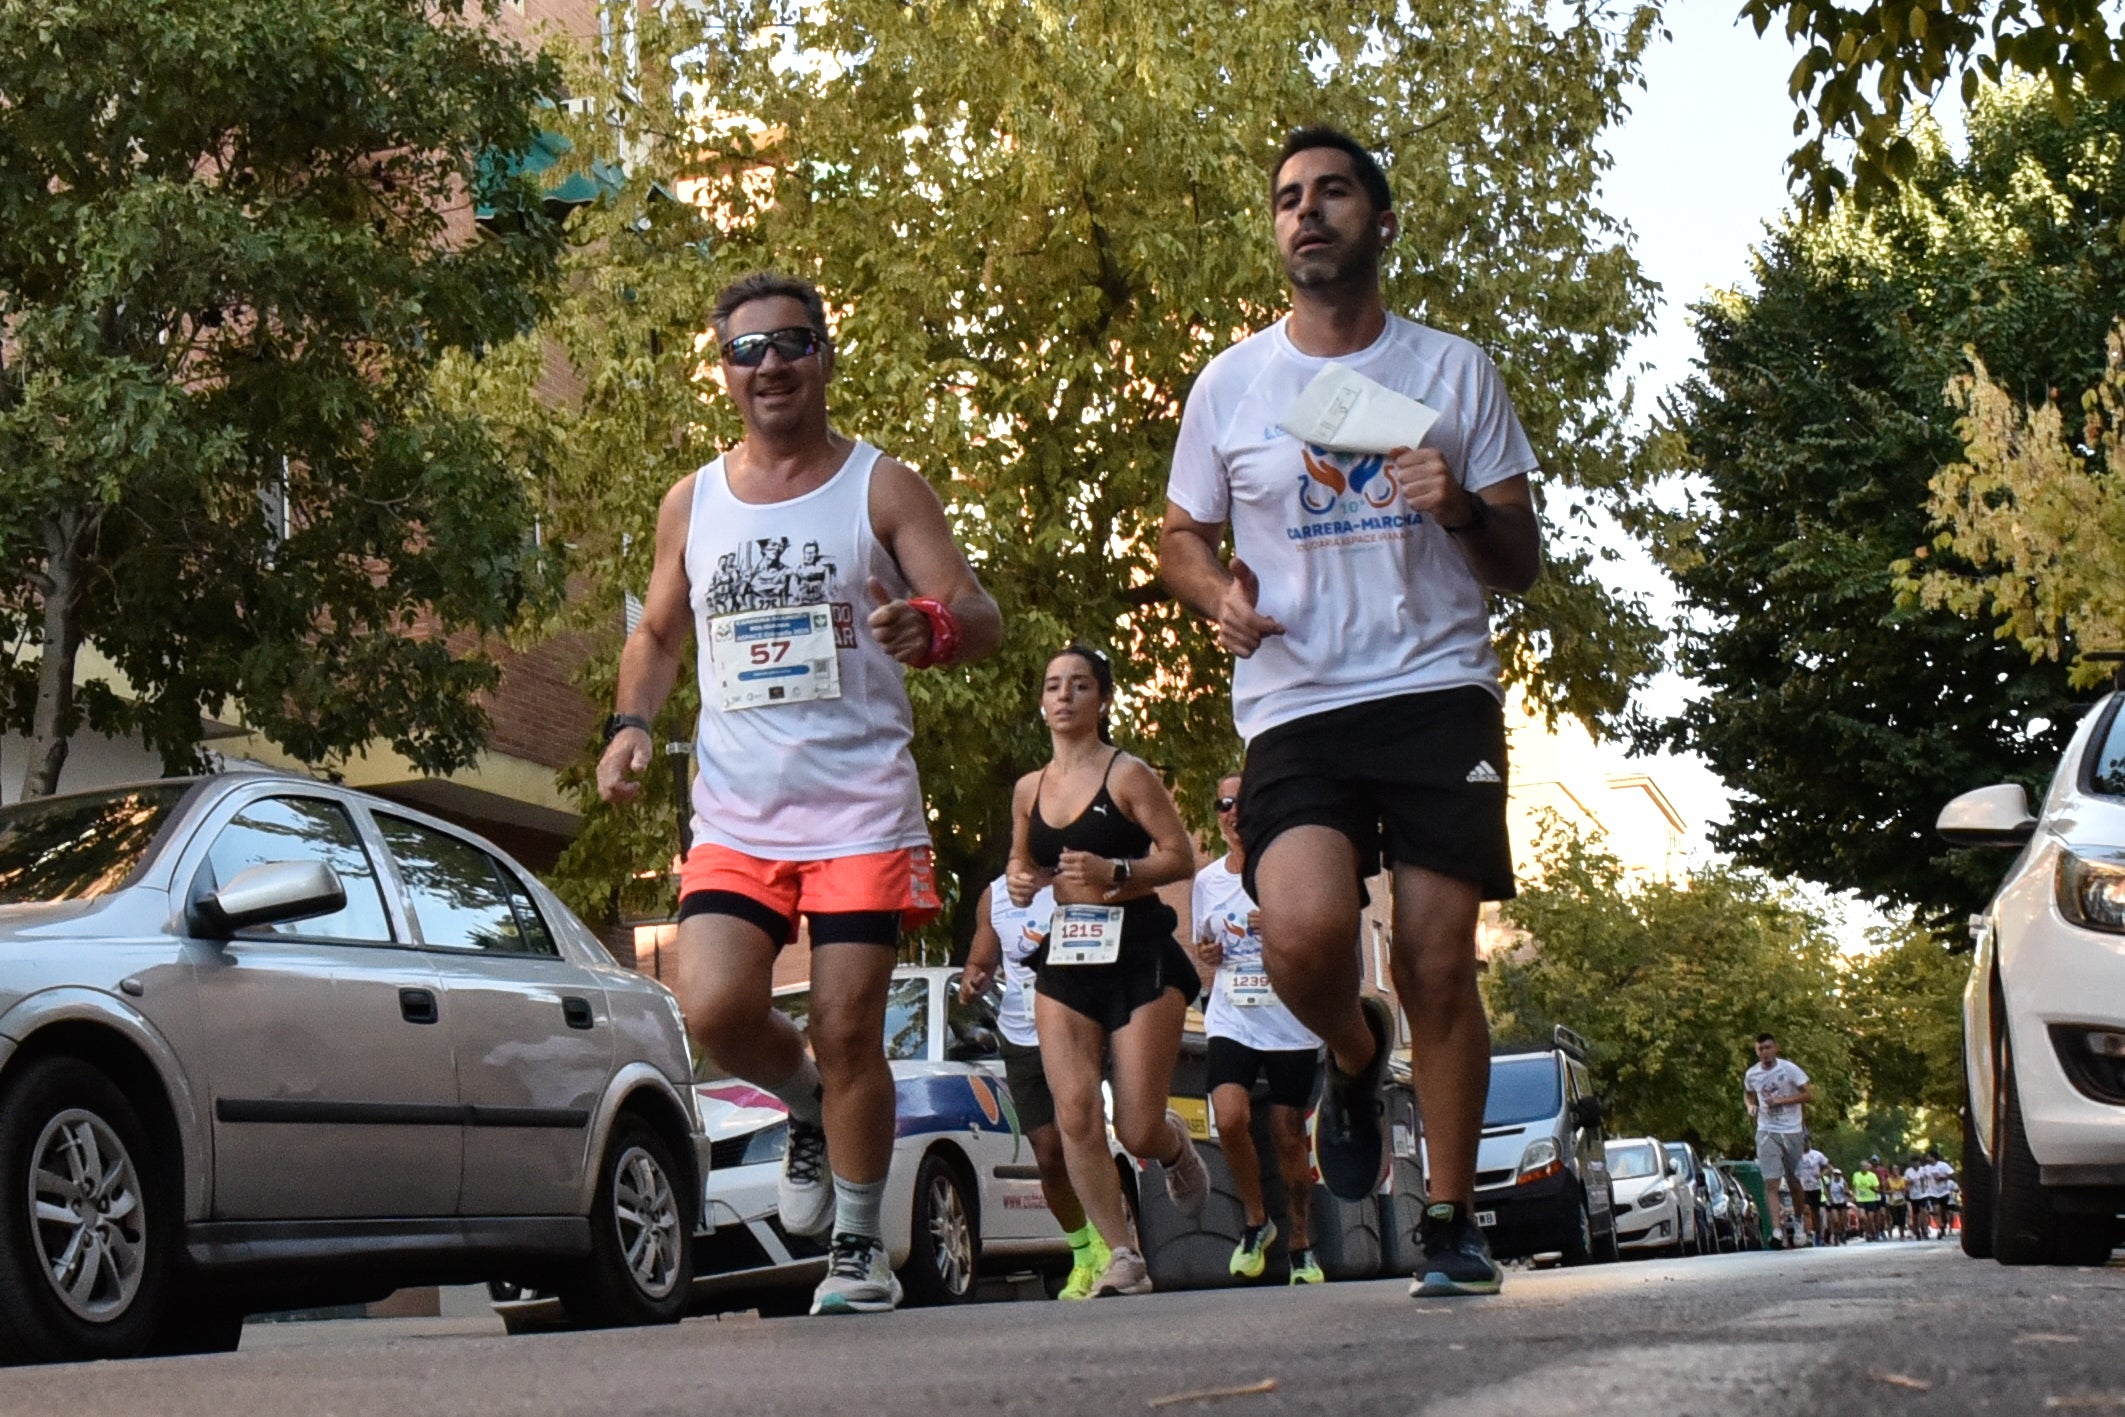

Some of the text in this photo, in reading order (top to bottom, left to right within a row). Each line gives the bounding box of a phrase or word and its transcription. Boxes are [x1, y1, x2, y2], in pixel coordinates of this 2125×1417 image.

[1287, 513, 1423, 540] CARRERA-MARCHA
[751, 641, 791, 665] 57
[1062, 924, 1103, 939] 1215
